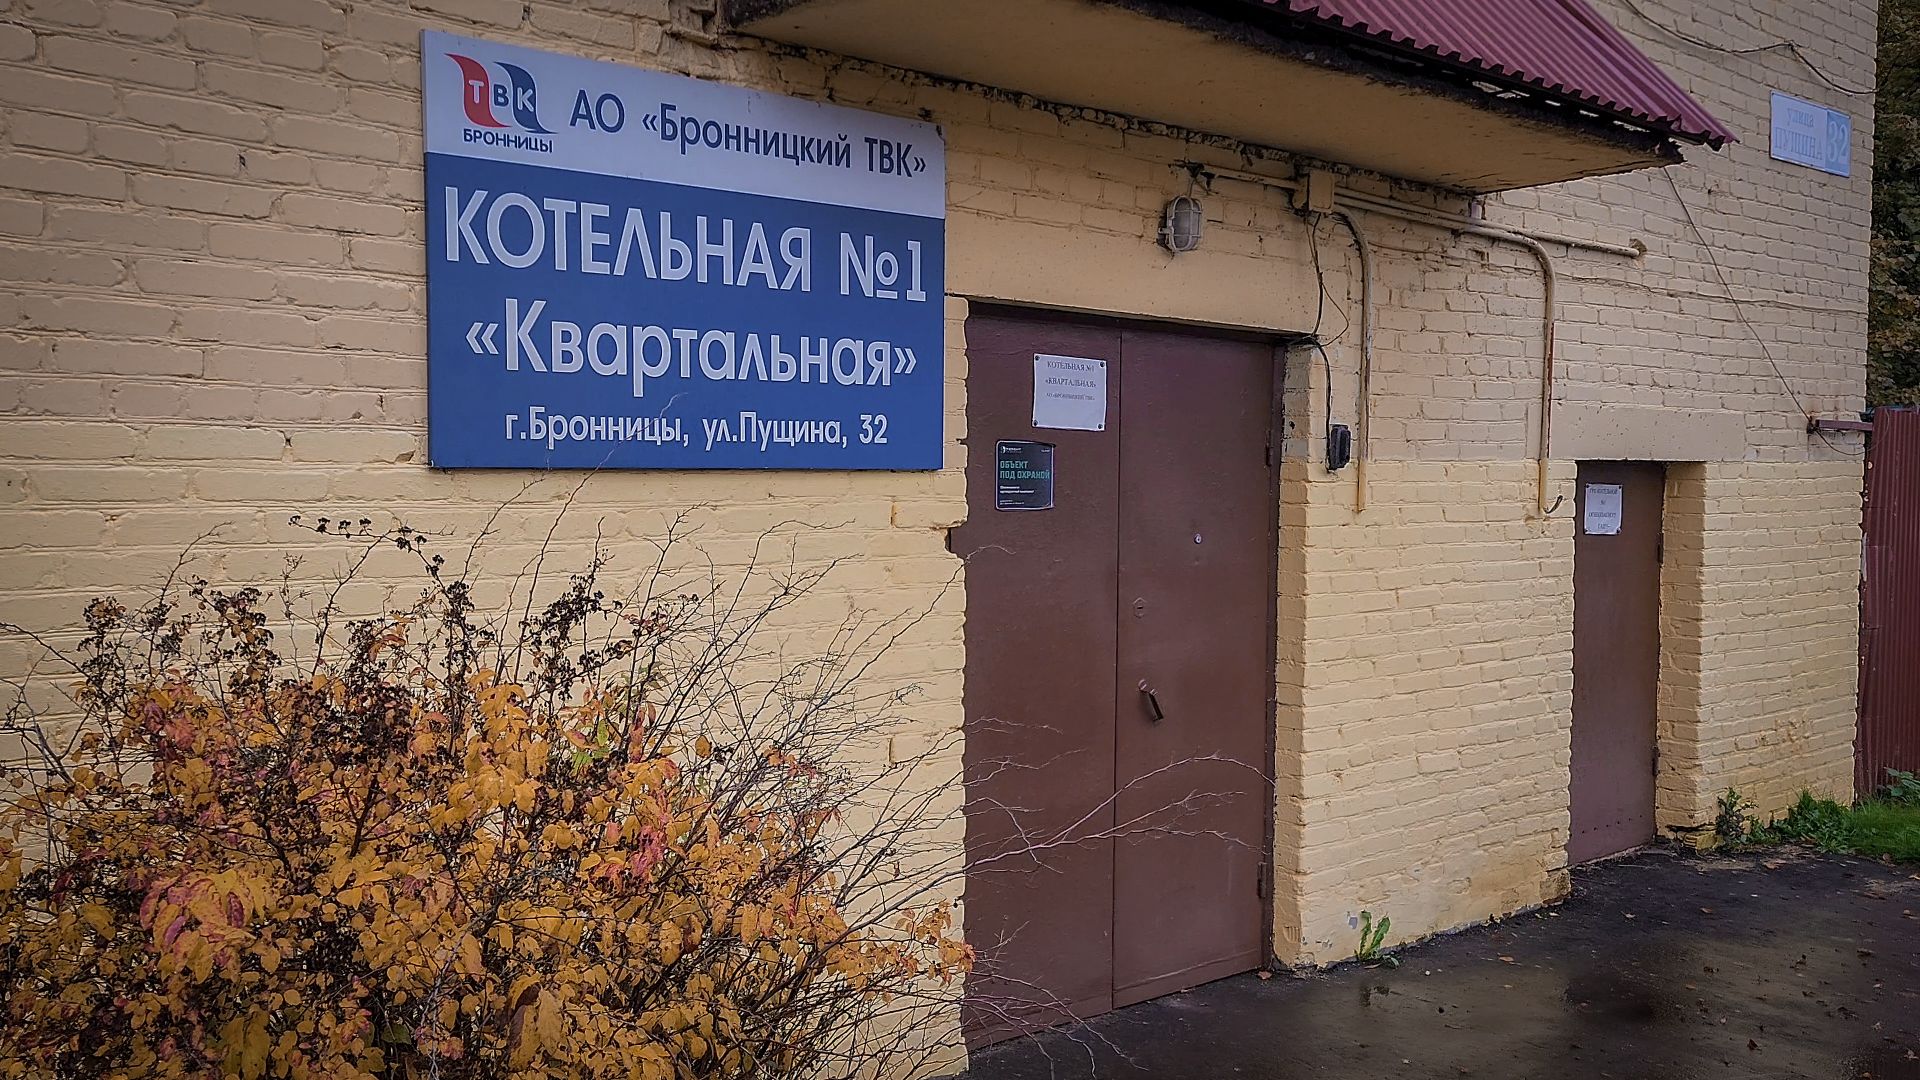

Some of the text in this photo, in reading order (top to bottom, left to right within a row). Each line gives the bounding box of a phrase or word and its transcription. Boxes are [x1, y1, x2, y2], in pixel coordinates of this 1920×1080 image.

[469, 80, 534, 112] ТВК
[463, 128, 553, 153] БРОННИЦЫ
[570, 89, 926, 178] АО «Бронницкий ТВК»
[1828, 121, 1848, 162] 32
[445, 186, 926, 302] КОТЕЛЬНАЯ №1
[465, 298, 917, 397] «Квартальная»
[1047, 361, 1085, 372] КОТЕЛЬНАЯ
[702, 411, 848, 451] ул.Пущина,
[859, 414, 888, 444] 32
[1000, 461, 1028, 469] ОБЪЕКТ
[1000, 469, 1050, 479] ПОД ОХРАНОЙ
